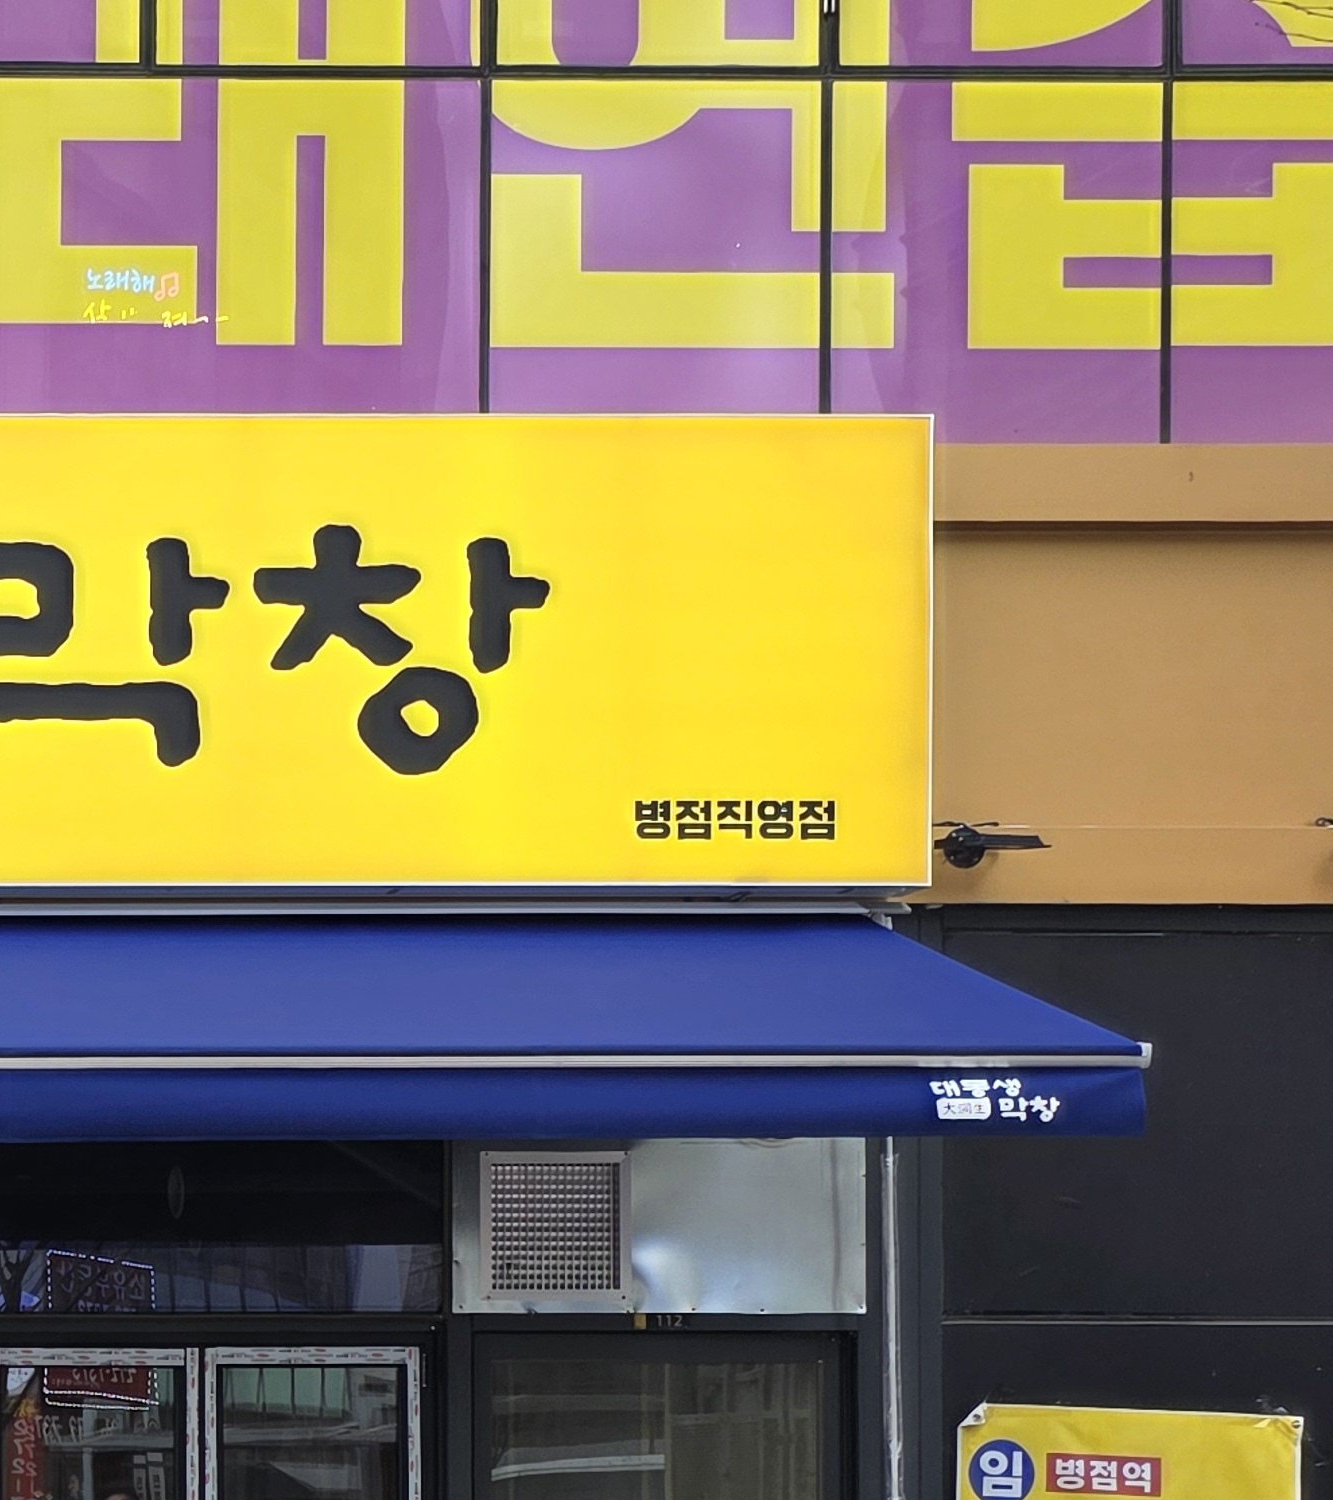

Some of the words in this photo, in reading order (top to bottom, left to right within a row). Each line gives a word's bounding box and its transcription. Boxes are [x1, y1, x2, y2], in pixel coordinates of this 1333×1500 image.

[634, 800, 837, 841] 병점직영점
[929, 1078, 1021, 1098] 대동생
[998, 1096, 1061, 1122] 막창
[656, 1314, 683, 1327] 112
[1055, 1458, 1152, 1493] 병점역
